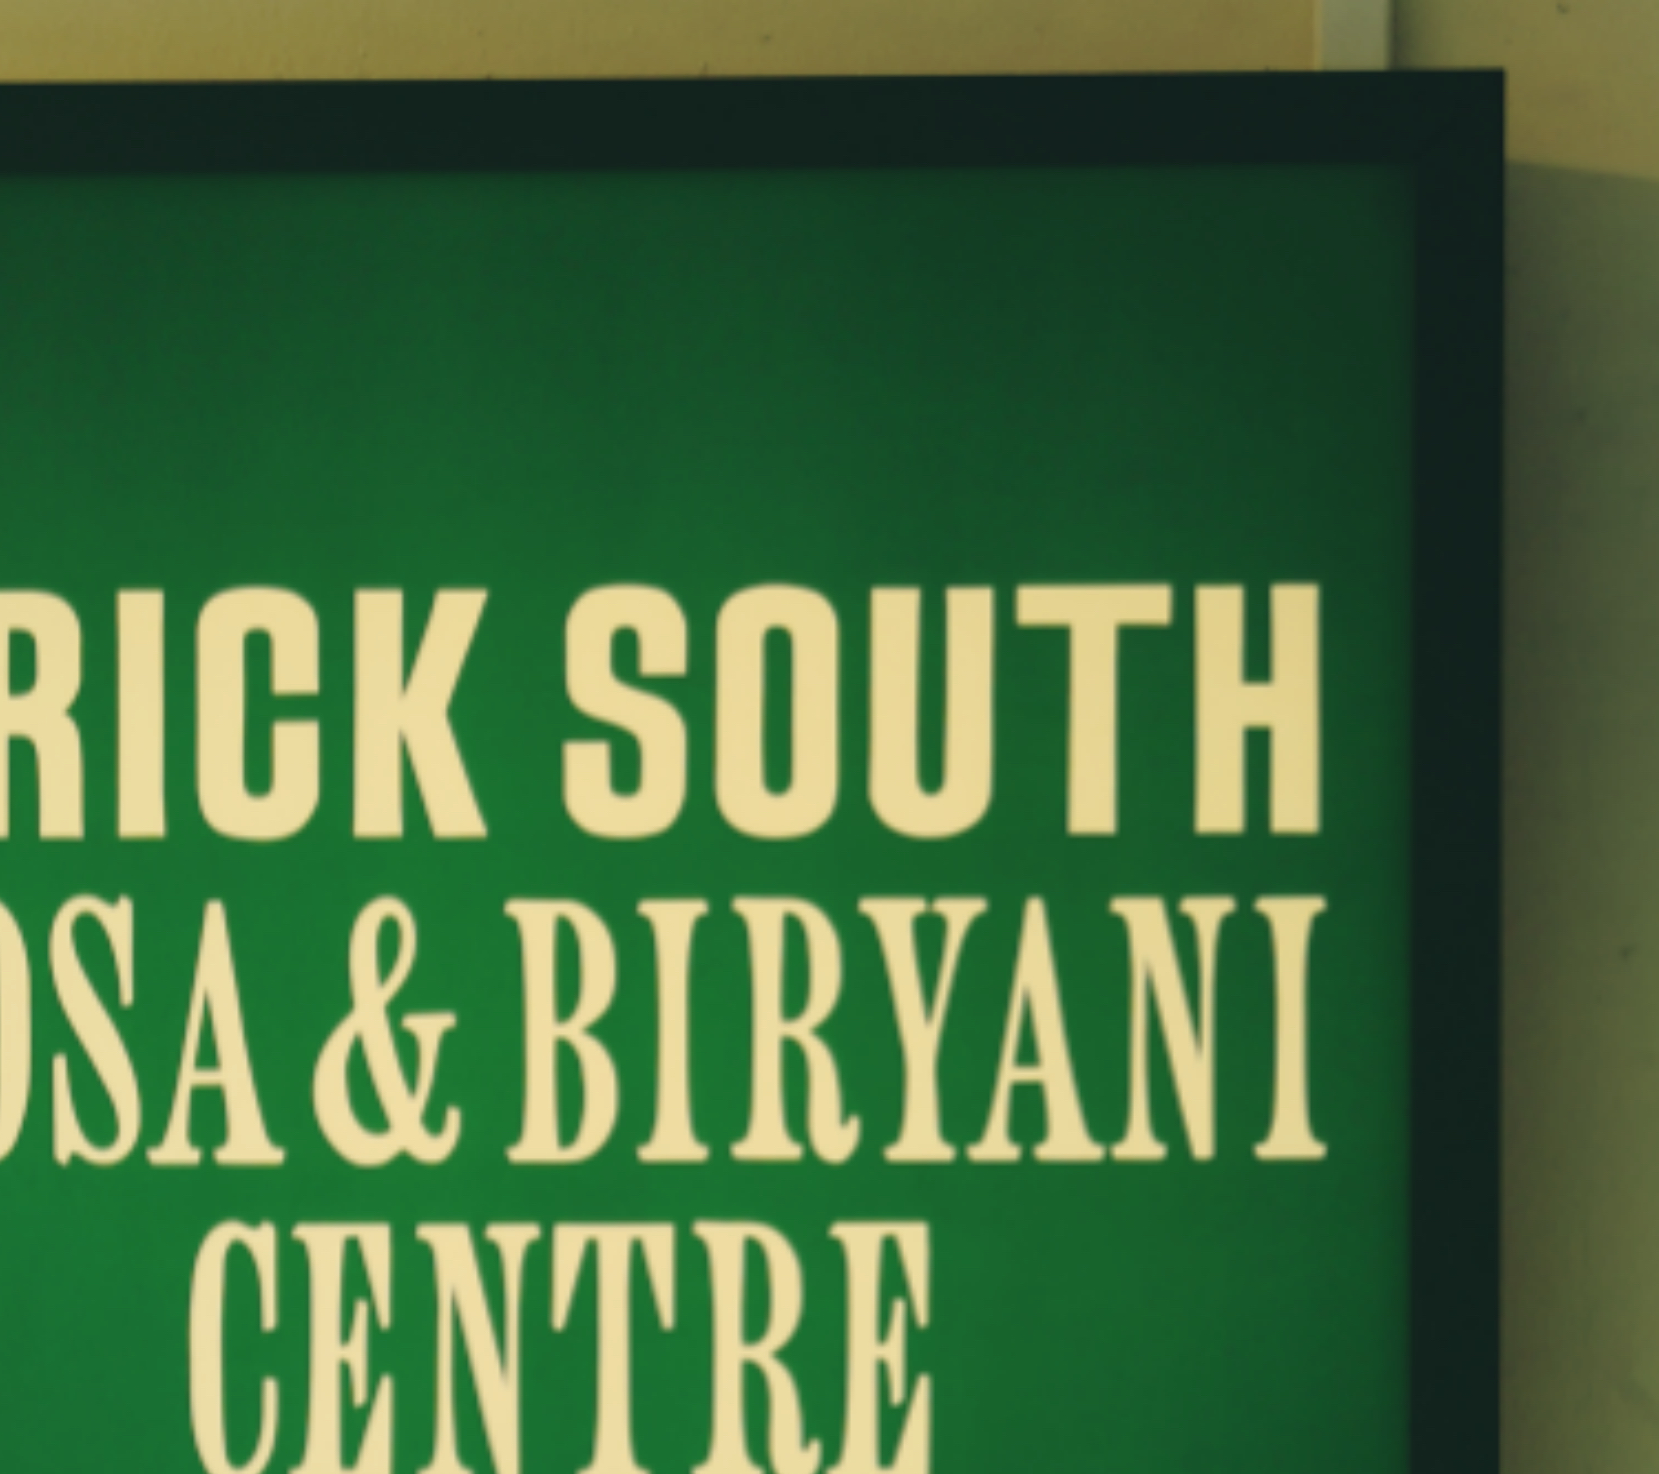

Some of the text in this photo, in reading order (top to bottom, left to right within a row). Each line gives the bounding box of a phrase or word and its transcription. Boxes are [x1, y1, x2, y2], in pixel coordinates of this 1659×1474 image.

[561, 582, 1321, 840] SOUTH
[310, 894, 462, 1168] &
[502, 894, 1327, 1165] BIRYANI
